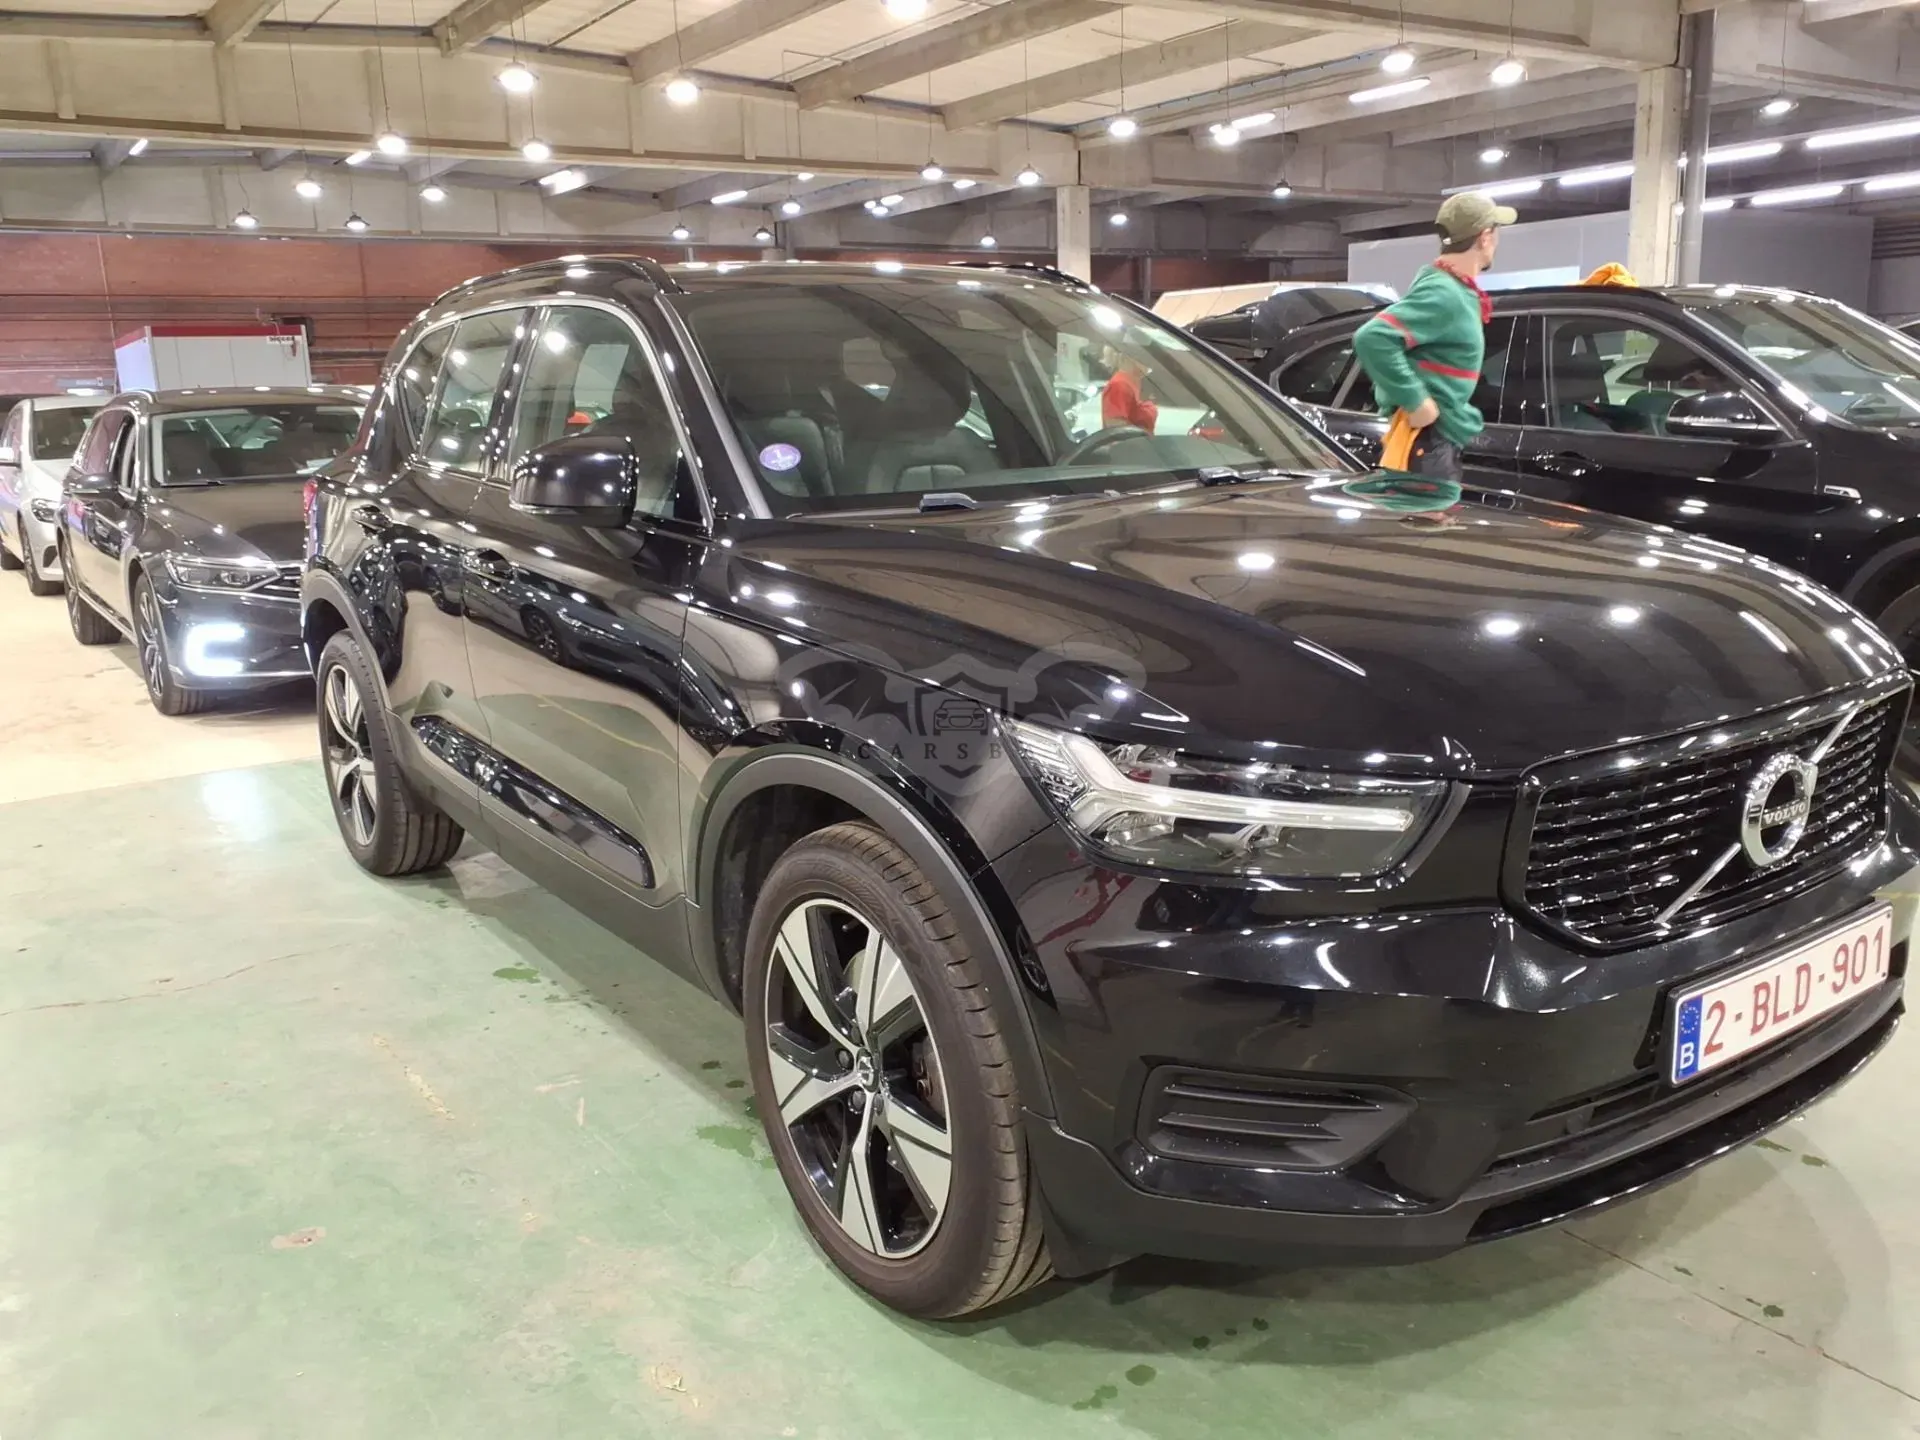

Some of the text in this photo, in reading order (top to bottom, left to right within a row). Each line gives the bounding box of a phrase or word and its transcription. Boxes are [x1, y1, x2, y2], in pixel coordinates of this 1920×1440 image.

[1763, 801, 1806, 825] VOLVO
[1703, 926, 1884, 1057] 2-BLD-901
[1680, 1041, 1695, 1070] B
